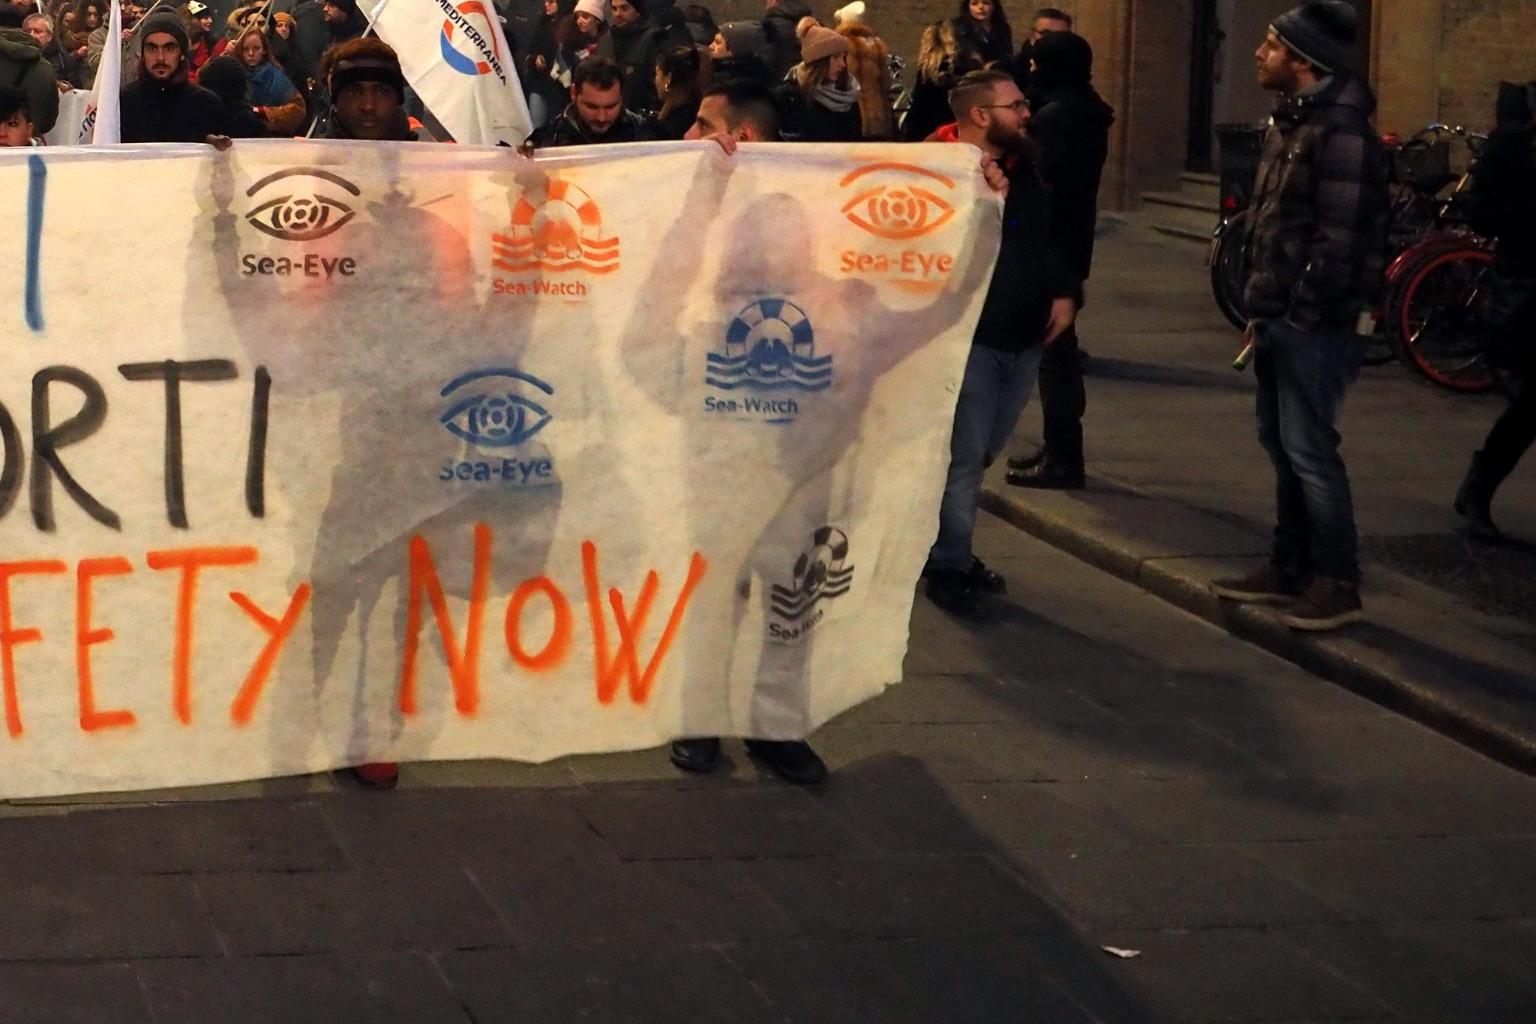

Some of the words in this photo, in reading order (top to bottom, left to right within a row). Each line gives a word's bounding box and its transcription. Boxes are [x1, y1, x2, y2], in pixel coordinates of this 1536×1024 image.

[242, 253, 357, 279] Sea-Eye
[840, 249, 953, 278] Sea-Eye
[493, 279, 588, 296] Sea-Watch
[704, 396, 799, 413] Sea-Watch
[439, 458, 552, 484] Sea-Eye
